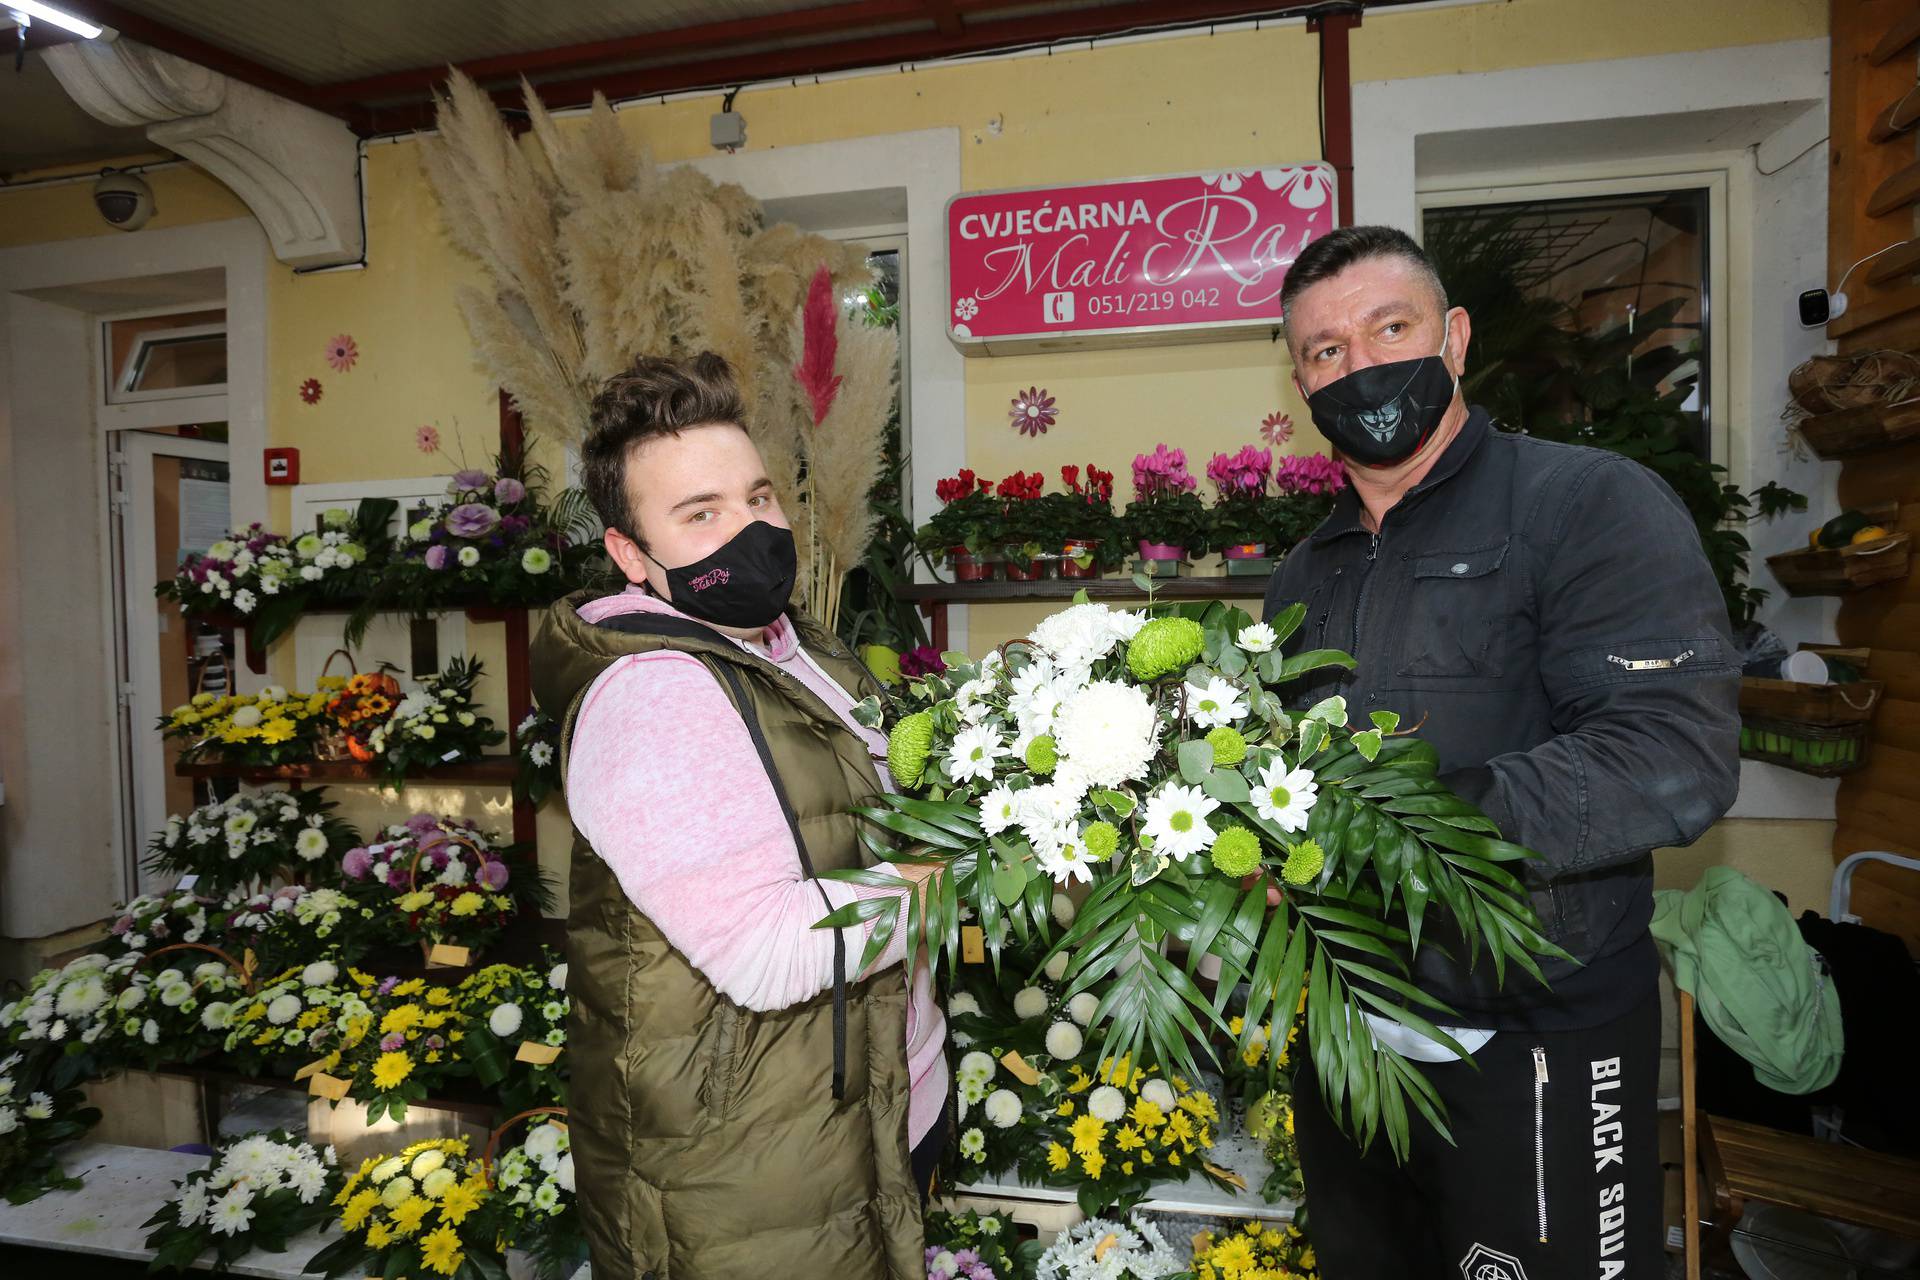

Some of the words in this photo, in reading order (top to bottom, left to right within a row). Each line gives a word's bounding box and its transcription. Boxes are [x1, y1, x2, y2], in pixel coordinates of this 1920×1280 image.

[959, 199, 1151, 240] CVJEĆARNA
[975, 231, 1129, 300] Mali
[1142, 188, 1318, 308] Raj
[1087, 291, 1175, 315] 051/219
[1181, 288, 1220, 309] 042
[1591, 1056, 1623, 1174] BLACK
[1598, 1183, 1625, 1280] SQUA
